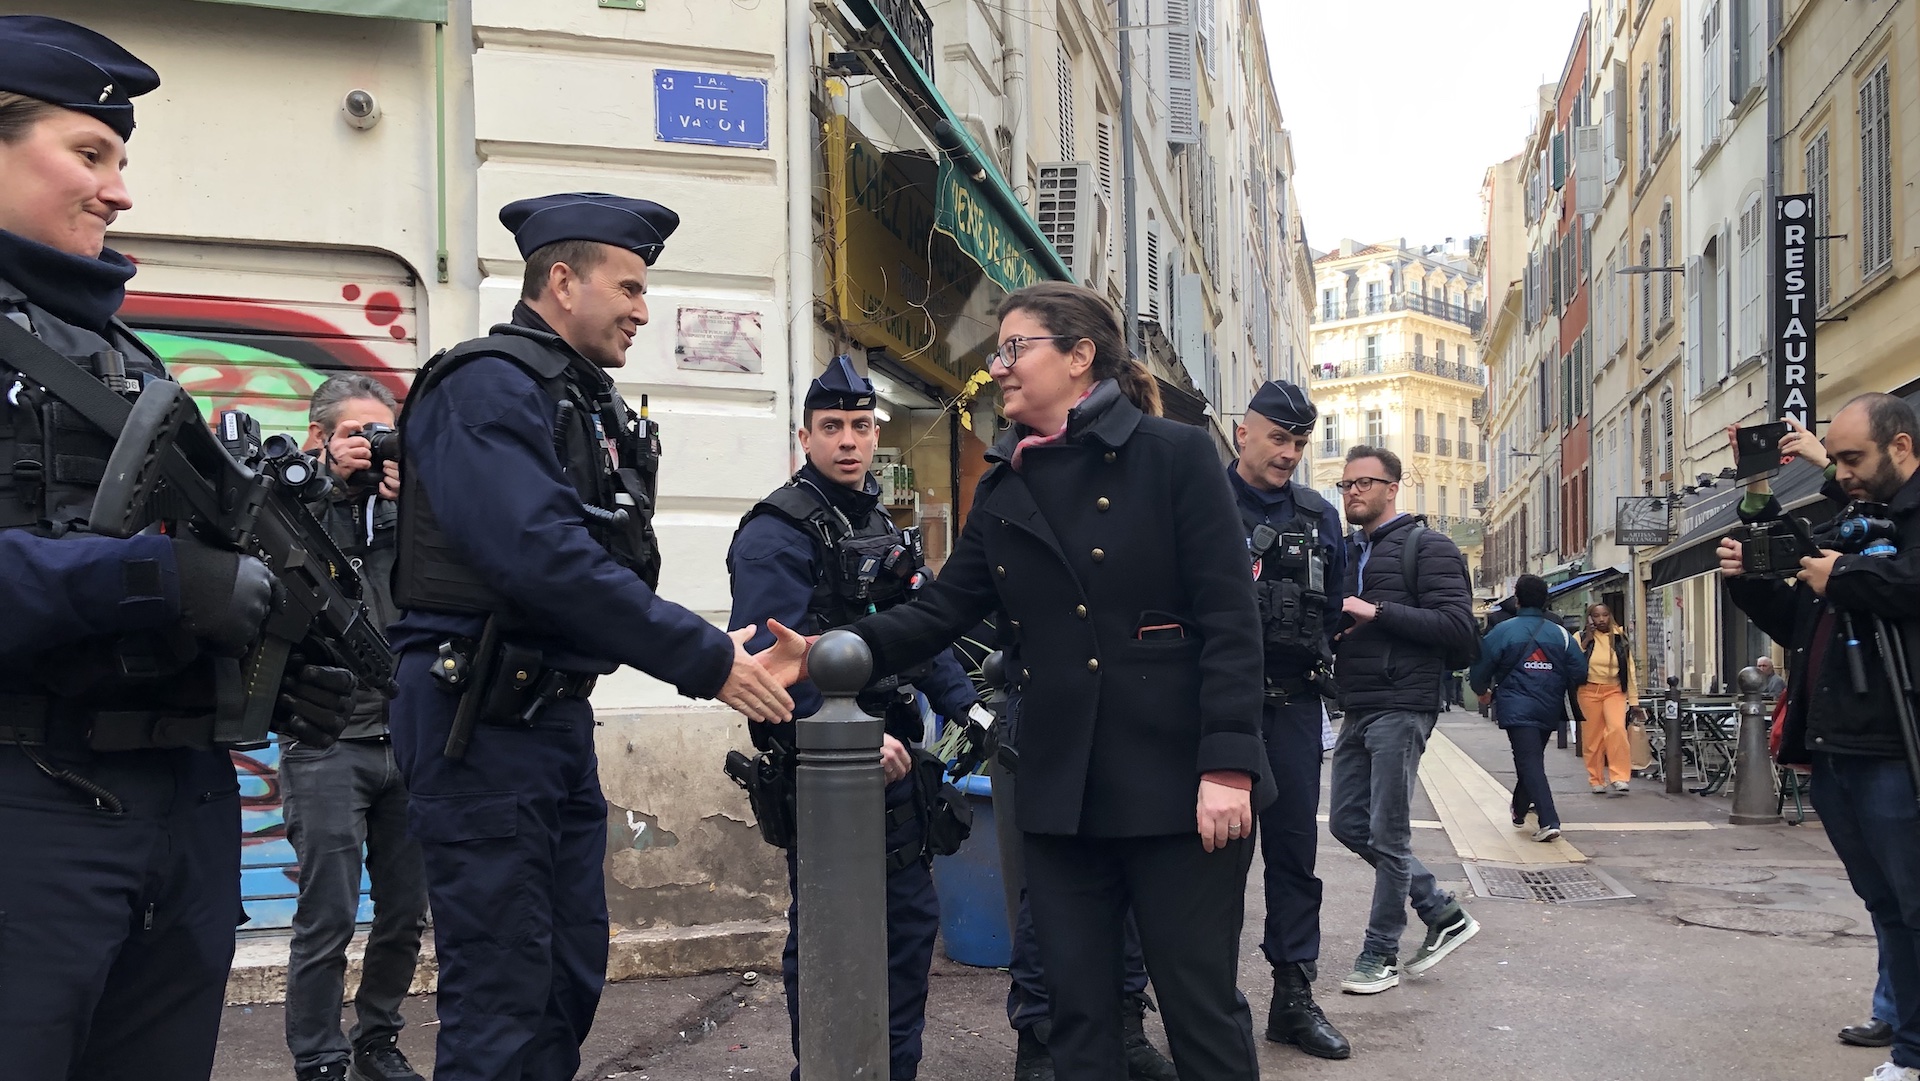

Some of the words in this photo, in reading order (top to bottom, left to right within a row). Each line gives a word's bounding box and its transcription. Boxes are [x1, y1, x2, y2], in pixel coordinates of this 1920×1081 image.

[695, 97, 728, 111] RUE
[680, 115, 745, 132] VAON
[1783, 225, 1807, 431] RESTAURAN
[1524, 661, 1553, 670] adidas
